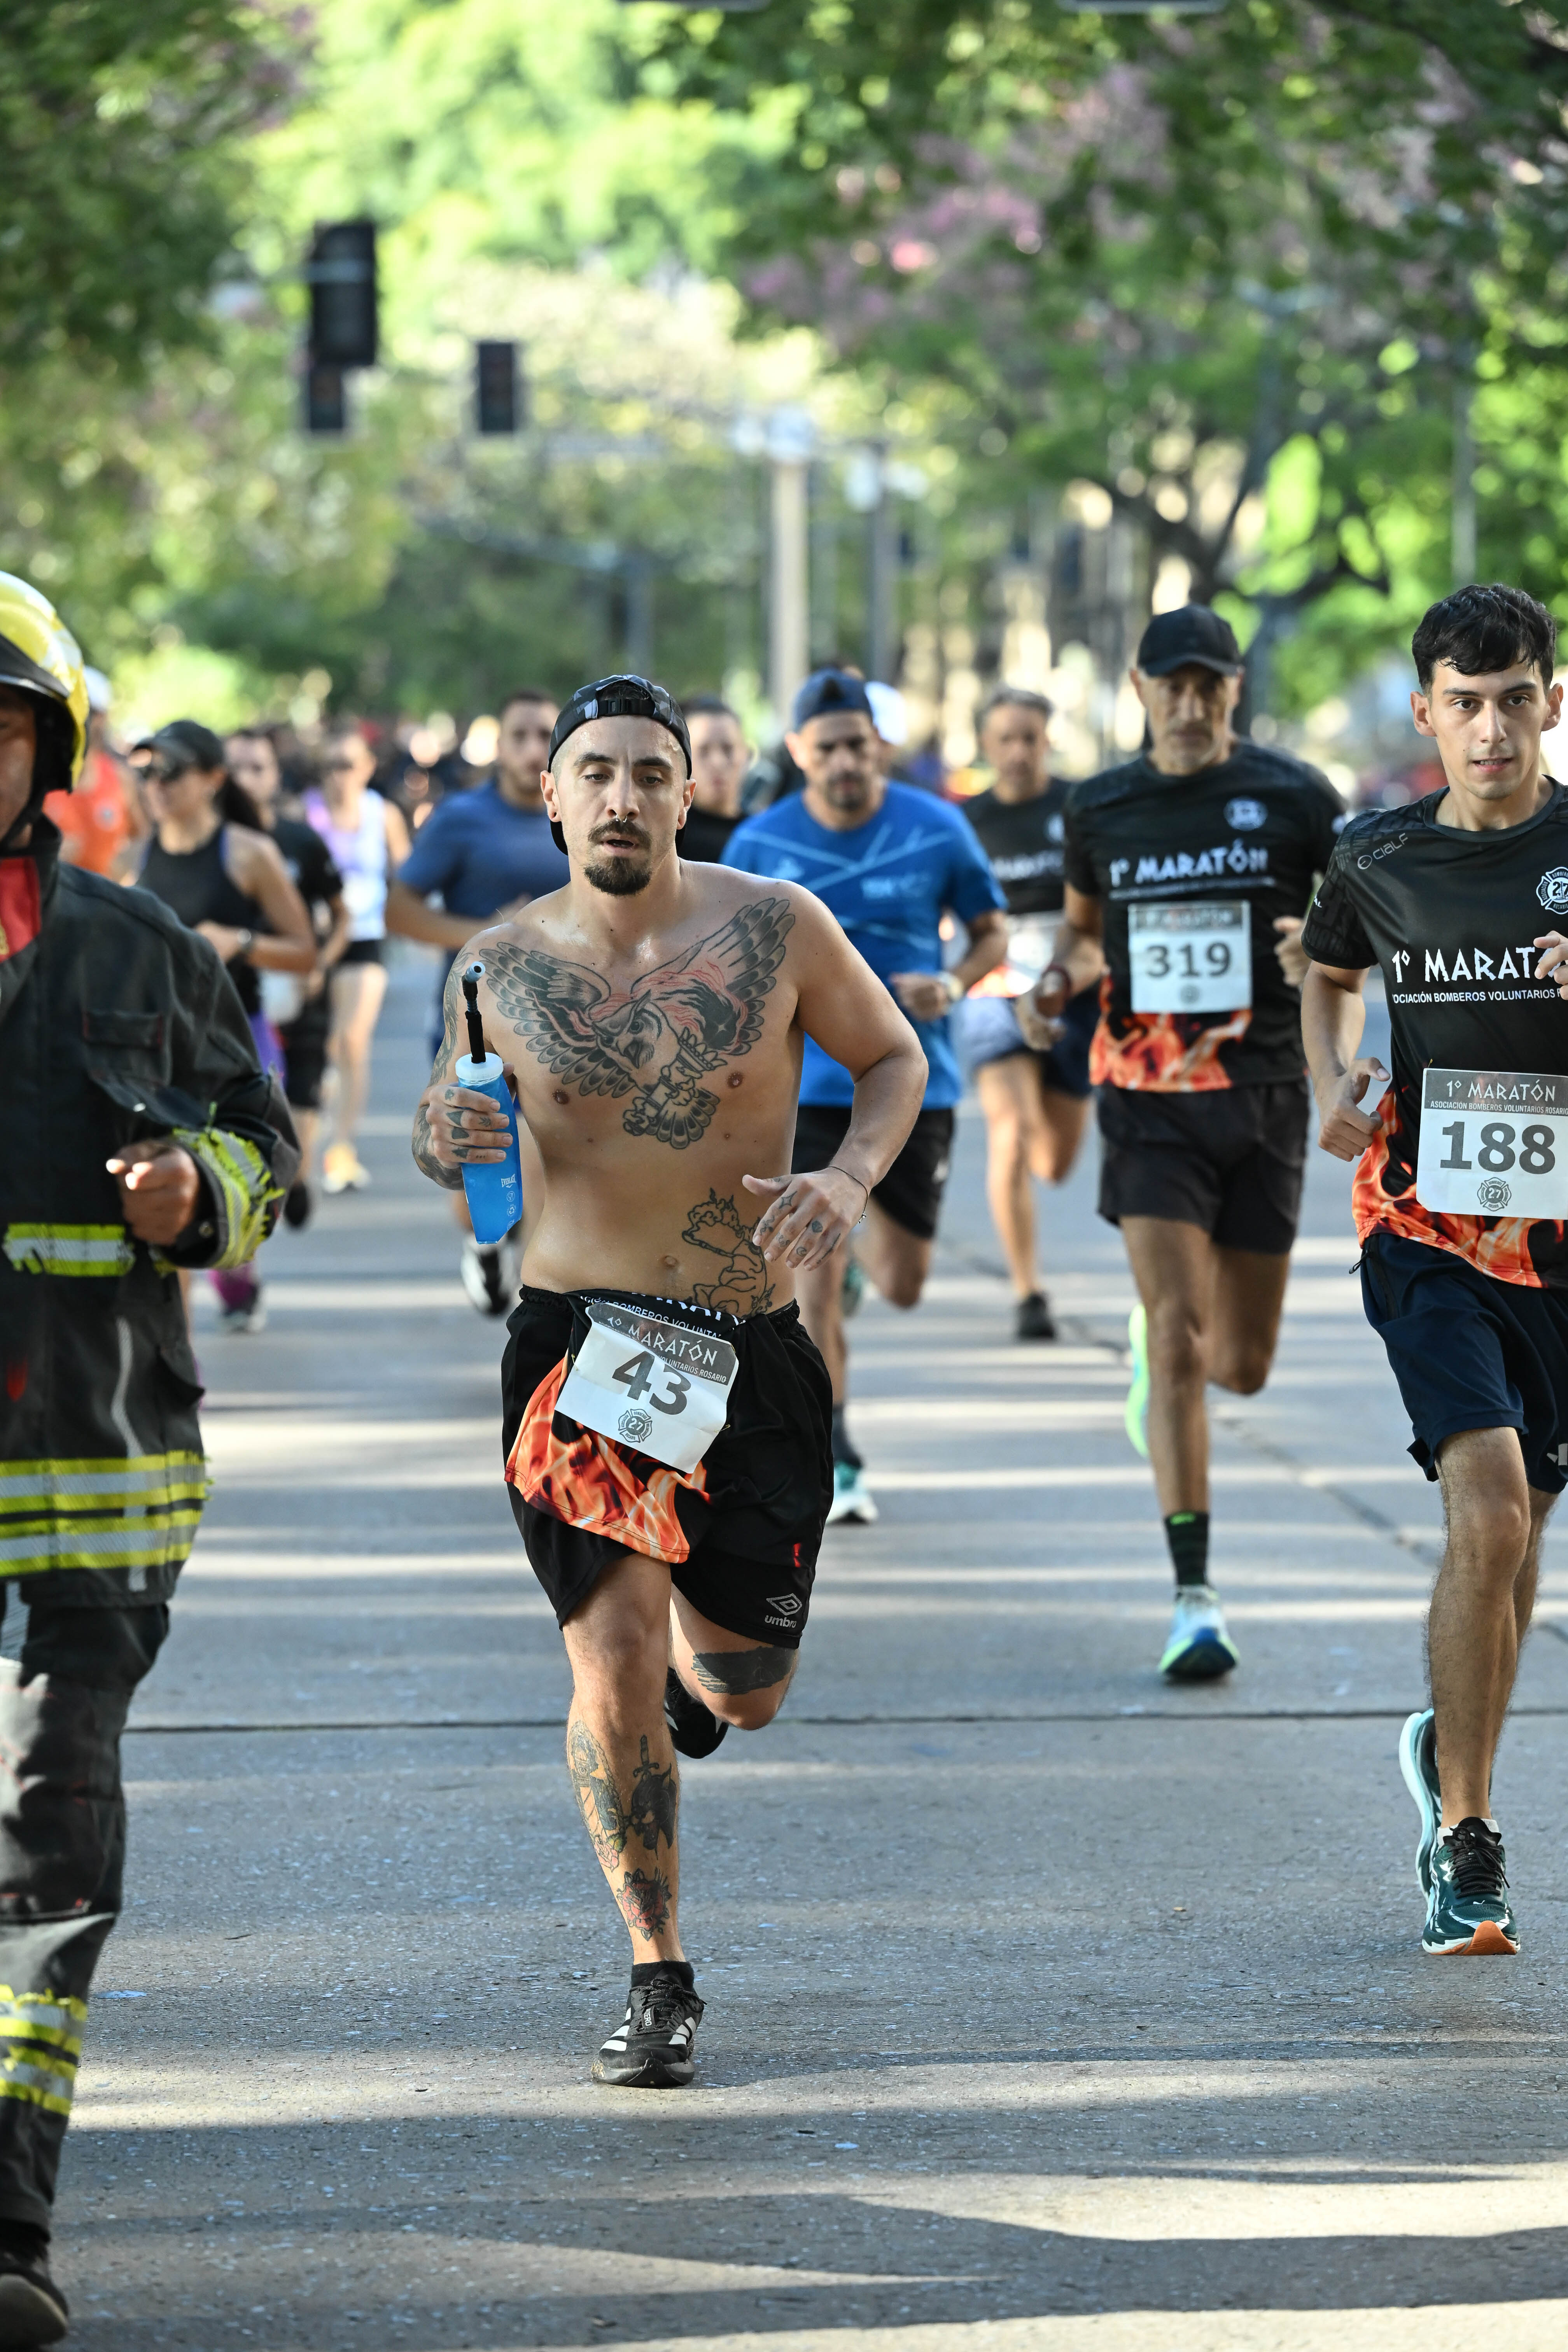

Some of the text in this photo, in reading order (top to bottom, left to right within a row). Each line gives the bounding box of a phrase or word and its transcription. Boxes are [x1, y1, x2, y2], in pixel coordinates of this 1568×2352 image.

[1135, 838, 1269, 884] MARATÓN
[1145, 942, 1232, 979] 319
[1392, 991, 1432, 1004] OCIACIÓN
[1433, 991, 1486, 1003] BOMBEROS
[1488, 989, 1556, 1001] VOLUNTARIOS
[1467, 1079, 1556, 1102] MARATÓN
[1430, 1101, 1568, 1116] ASOCIACIÓN BOMBEROS VOLUNTARIOS ROSARIO
[1440, 1121, 1556, 1175] 188
[500, 1173, 516, 1188] EVERLAST
[1488, 1187, 1502, 1199] 27
[628, 1323, 718, 1367] MARATÓN
[611, 1350, 692, 1415] 43
[699, 1369, 726, 1383] ROSARIO
[628, 1418, 644, 1431] 27
[765, 1615, 797, 1628] umbro
